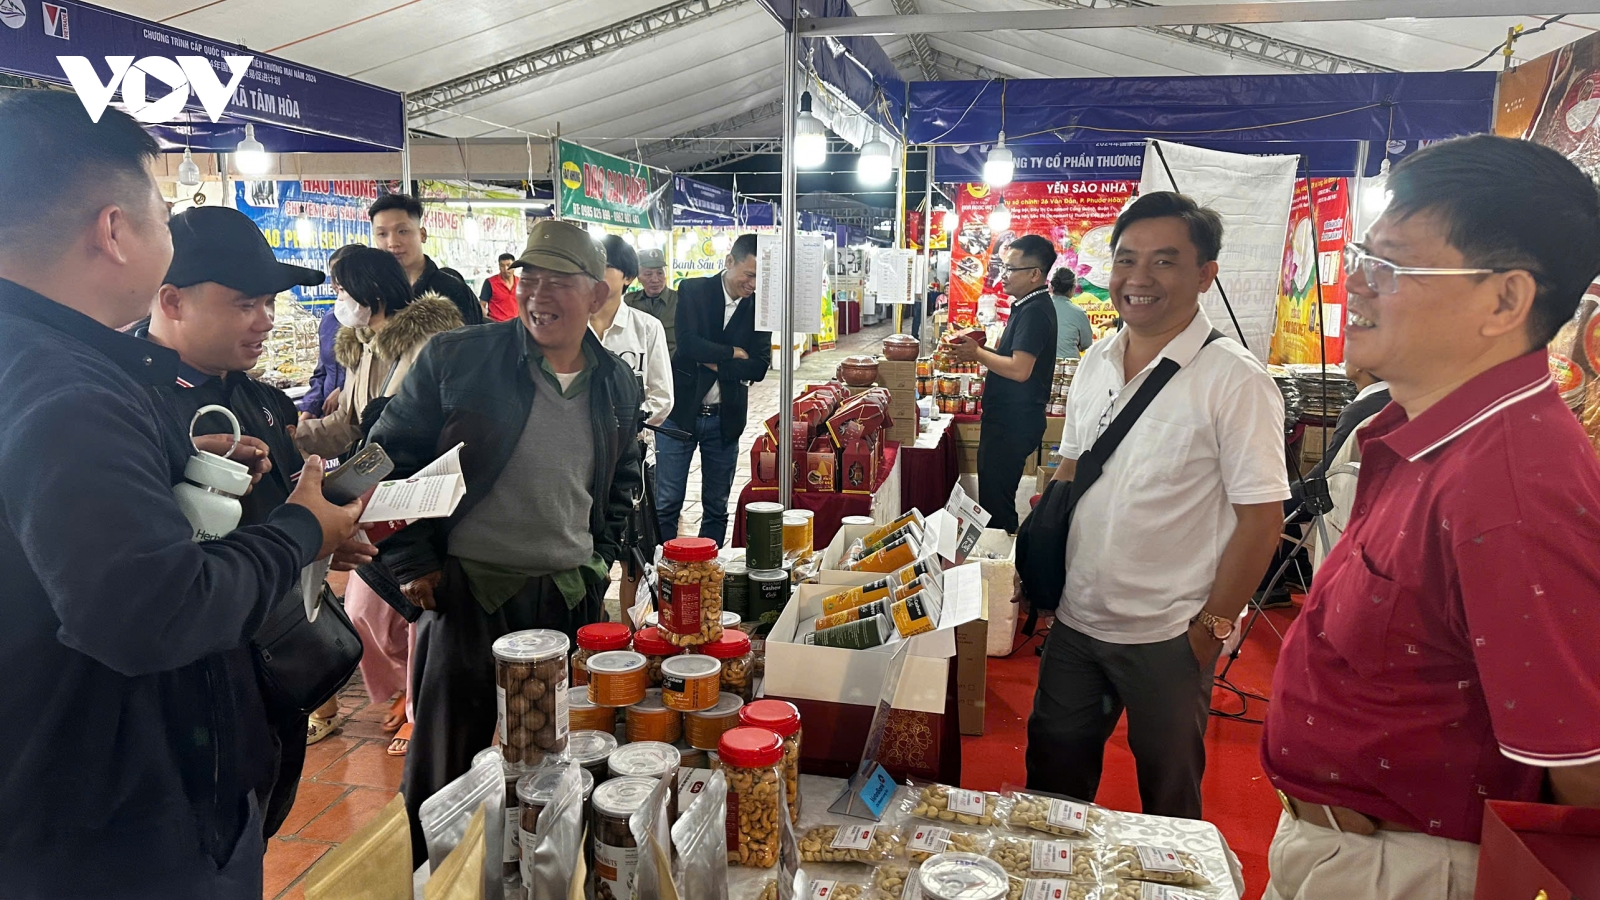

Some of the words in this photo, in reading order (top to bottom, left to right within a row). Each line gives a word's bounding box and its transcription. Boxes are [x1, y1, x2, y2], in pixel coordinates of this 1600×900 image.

[143, 29, 169, 44] CHƯƠNG
[171, 35, 189, 50] TRÌNH
[204, 45, 220, 57] QUỐC
[305, 72, 317, 83] 2024
[249, 88, 276, 113] TÂM
[278, 94, 300, 119] HÒA
[1012, 157, 1028, 169] NG
[1030, 157, 1043, 168] TY
[1045, 152, 1062, 168] CỔ
[1063, 152, 1095, 168] PHẦN
[1096, 154, 1141, 167] THƯƠNG
[1046, 181, 1068, 194] YẾN
[1072, 180, 1097, 193] SÀO
[1101, 183, 1127, 193] NHA
